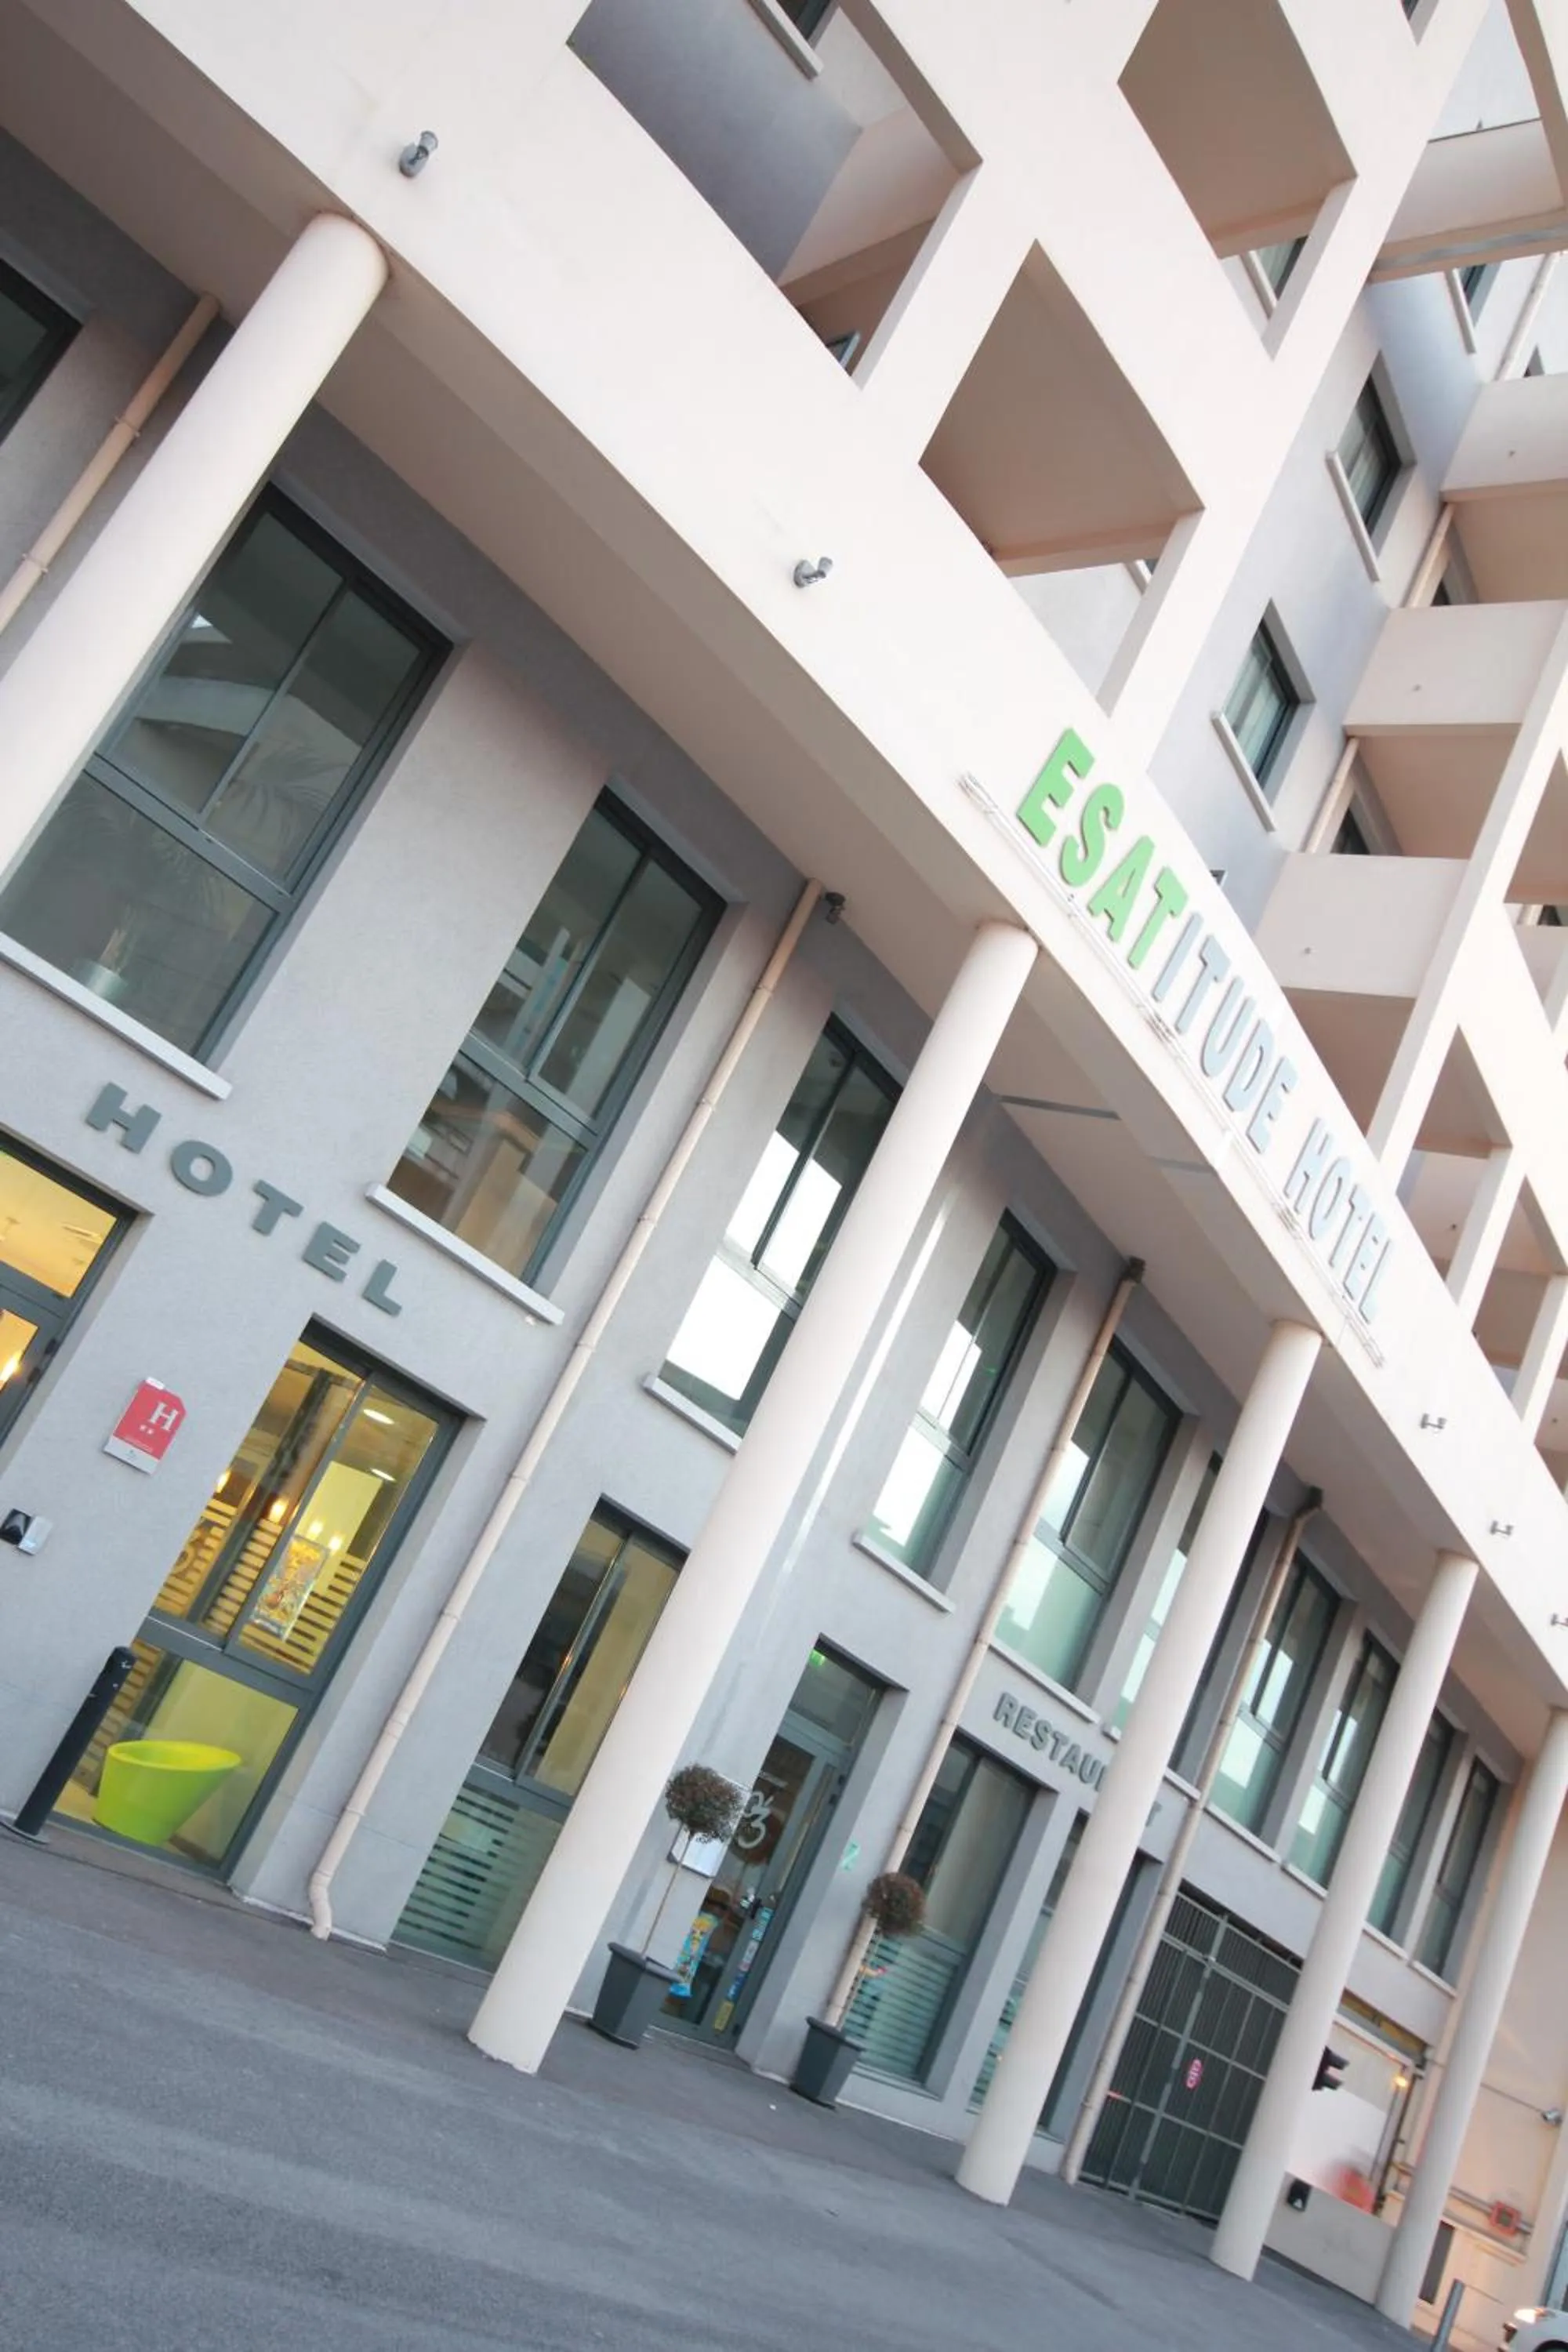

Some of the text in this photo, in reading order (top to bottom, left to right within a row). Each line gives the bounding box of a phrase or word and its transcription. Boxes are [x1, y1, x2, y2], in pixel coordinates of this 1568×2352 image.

[1016, 727, 1392, 1325] ESATITUDE HOTEL
[85, 1082, 402, 1317] HOTEL
[148, 1401, 179, 1432] H
